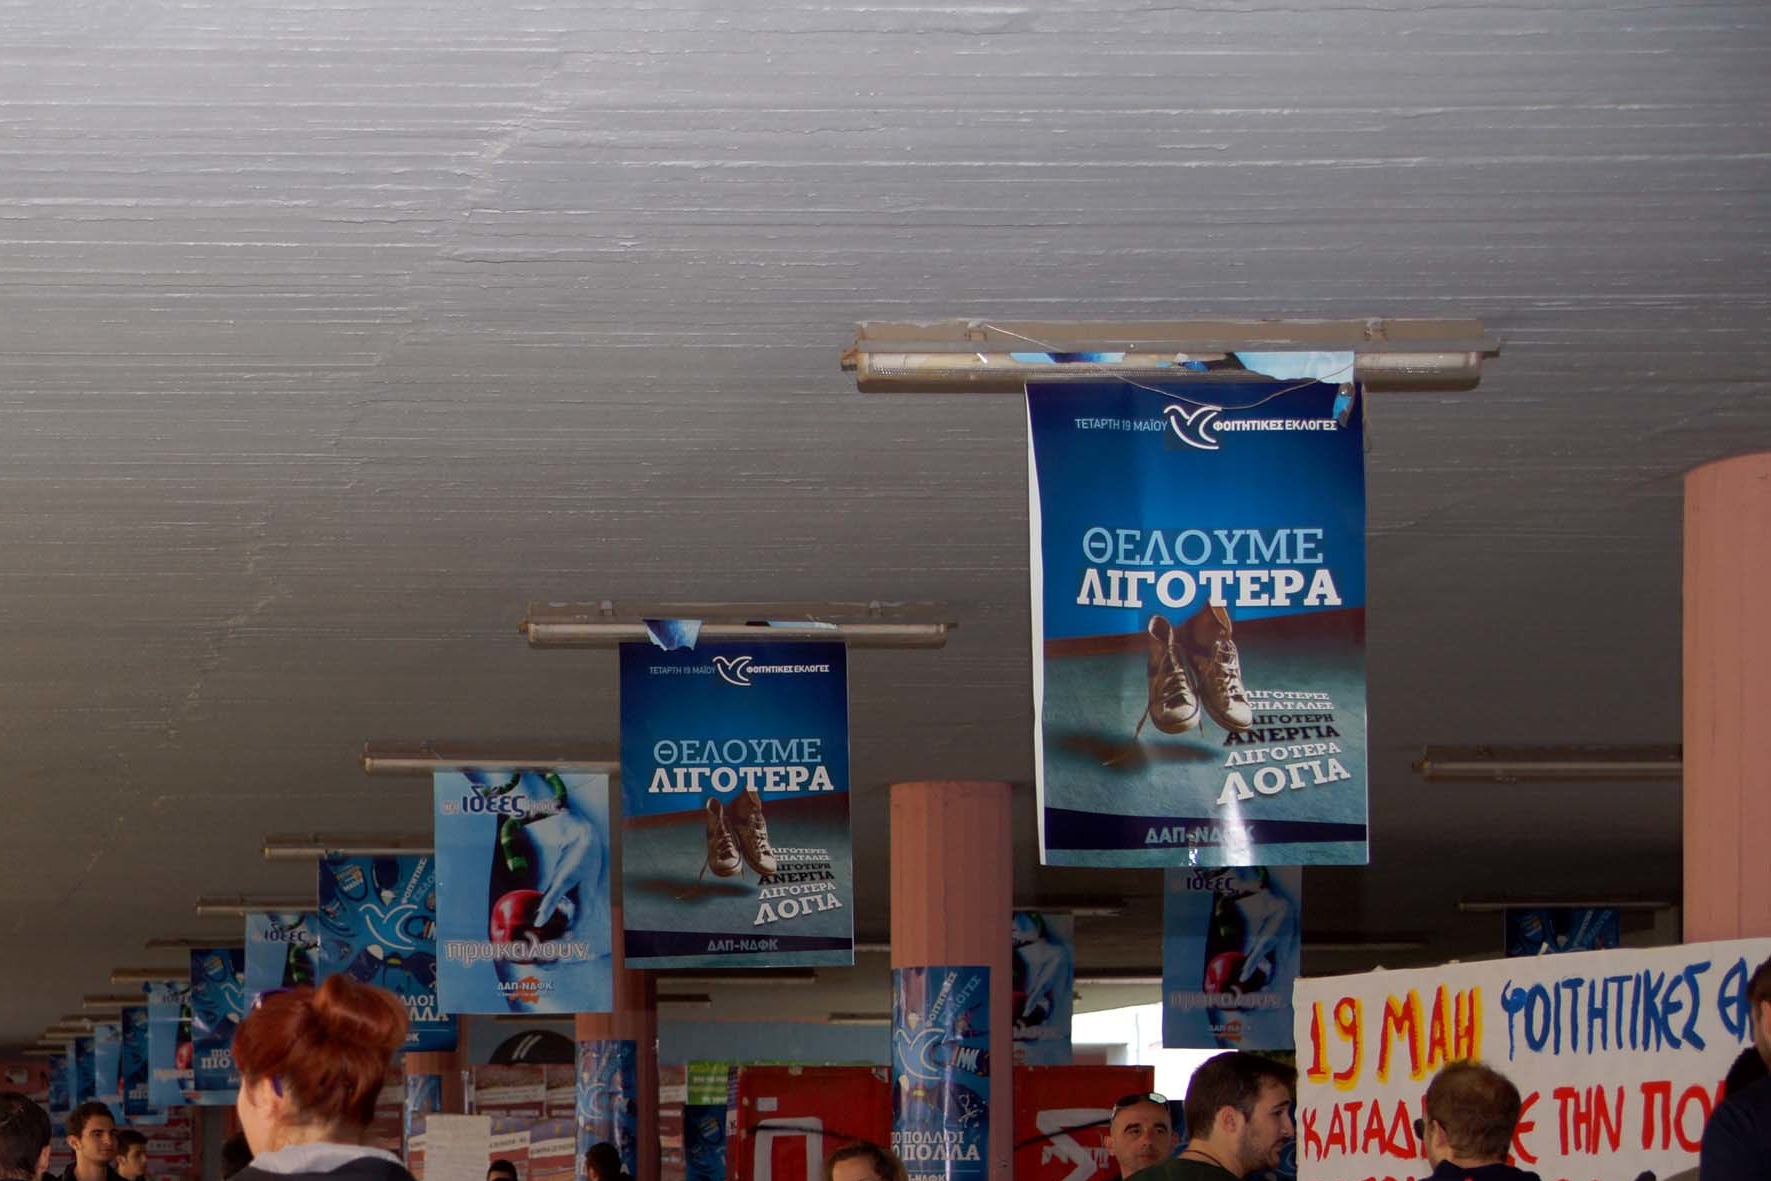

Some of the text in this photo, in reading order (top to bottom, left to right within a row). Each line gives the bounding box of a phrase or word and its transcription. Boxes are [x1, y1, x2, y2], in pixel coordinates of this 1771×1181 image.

[1076, 418, 1120, 430] ΤΕΤΑΡΤΗ
[1212, 419, 1284, 431] ΦΟΙΤΗΤΙΚΕΣ
[1285, 419, 1338, 431] ΕΚΛΟΓΕΣ
[1082, 526, 1324, 566] ΘΕΛΟΥΜΕ
[1076, 568, 1343, 608] ΛΙΓΟΤΕΡΑ
[795, 664, 830, 673] ΕΚΛΟΓΕΣ
[1223, 725, 1340, 746] ΑΝΕΡΓΙΑ
[653, 738, 822, 765] ΘΕΛΟΥΜΕ
[1224, 742, 1342, 768] ΛΙΓΟΤΕΡΑ
[648, 766, 835, 793] ΛΙΓΟΤΕΡΑ
[1216, 758, 1352, 805] ΛΟΓΙΑ
[759, 871, 834, 886] ΑΝΕΡΓΙΑ
[759, 882, 837, 901] ΛΙΓΟΤΕΡΑ
[754, 893, 844, 926] ΛΟΓΙΑ
[707, 938, 779, 952] ΔΑΠ-ΝΔΦΚ
[1306, 996, 1363, 1091] 19
[1378, 983, 1484, 1084] ΜΑΗ
[1553, 1084, 1625, 1156] ΤΗΝ
[903, 1143, 980, 1161] ΠΟΛΛΑ
